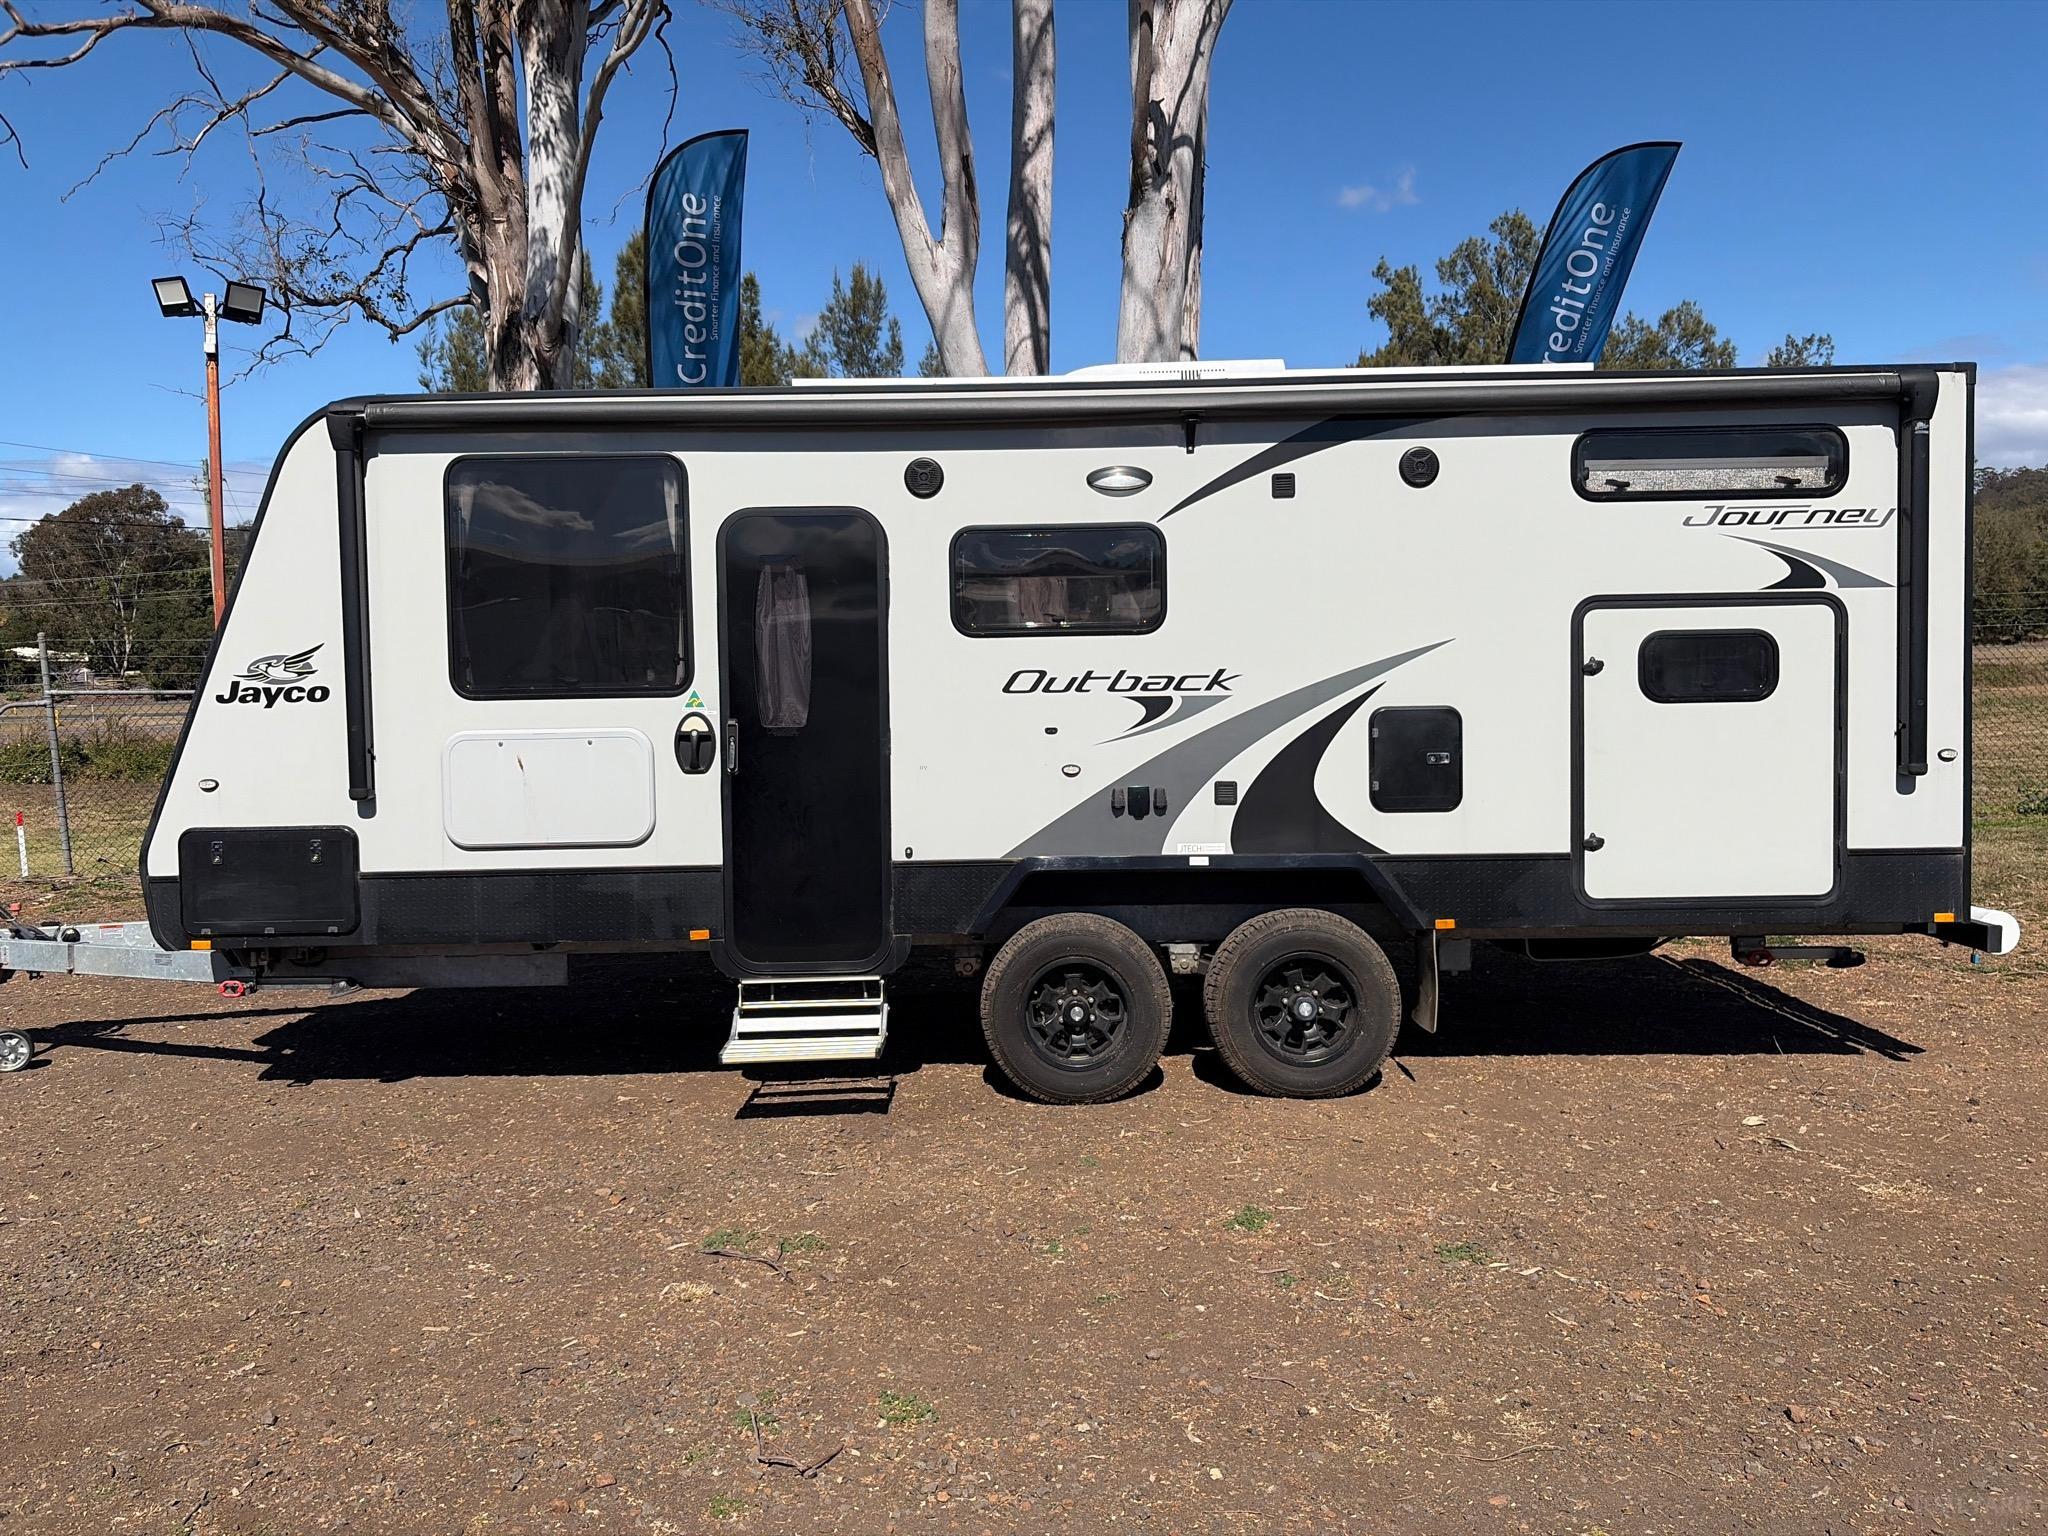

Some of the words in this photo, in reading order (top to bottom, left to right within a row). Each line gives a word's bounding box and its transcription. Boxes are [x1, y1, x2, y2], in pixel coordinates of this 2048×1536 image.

[712, 195, 722, 242] Insurance
[1608, 207, 1631, 256] Insurance
[712, 244, 720, 263] and
[1603, 256, 1614, 277] and
[674, 192, 706, 384] CreditOne
[711, 265, 720, 301] Finance
[1542, 202, 1615, 364] reditOne
[1587, 278, 1606, 315] Finance
[710, 303, 719, 341] Smarter
[1574, 316, 1592, 354] Smarter
[1682, 504, 1896, 530] Journey
[215, 680, 331, 709] Jayco
[1001, 668, 1244, 694] Outback
